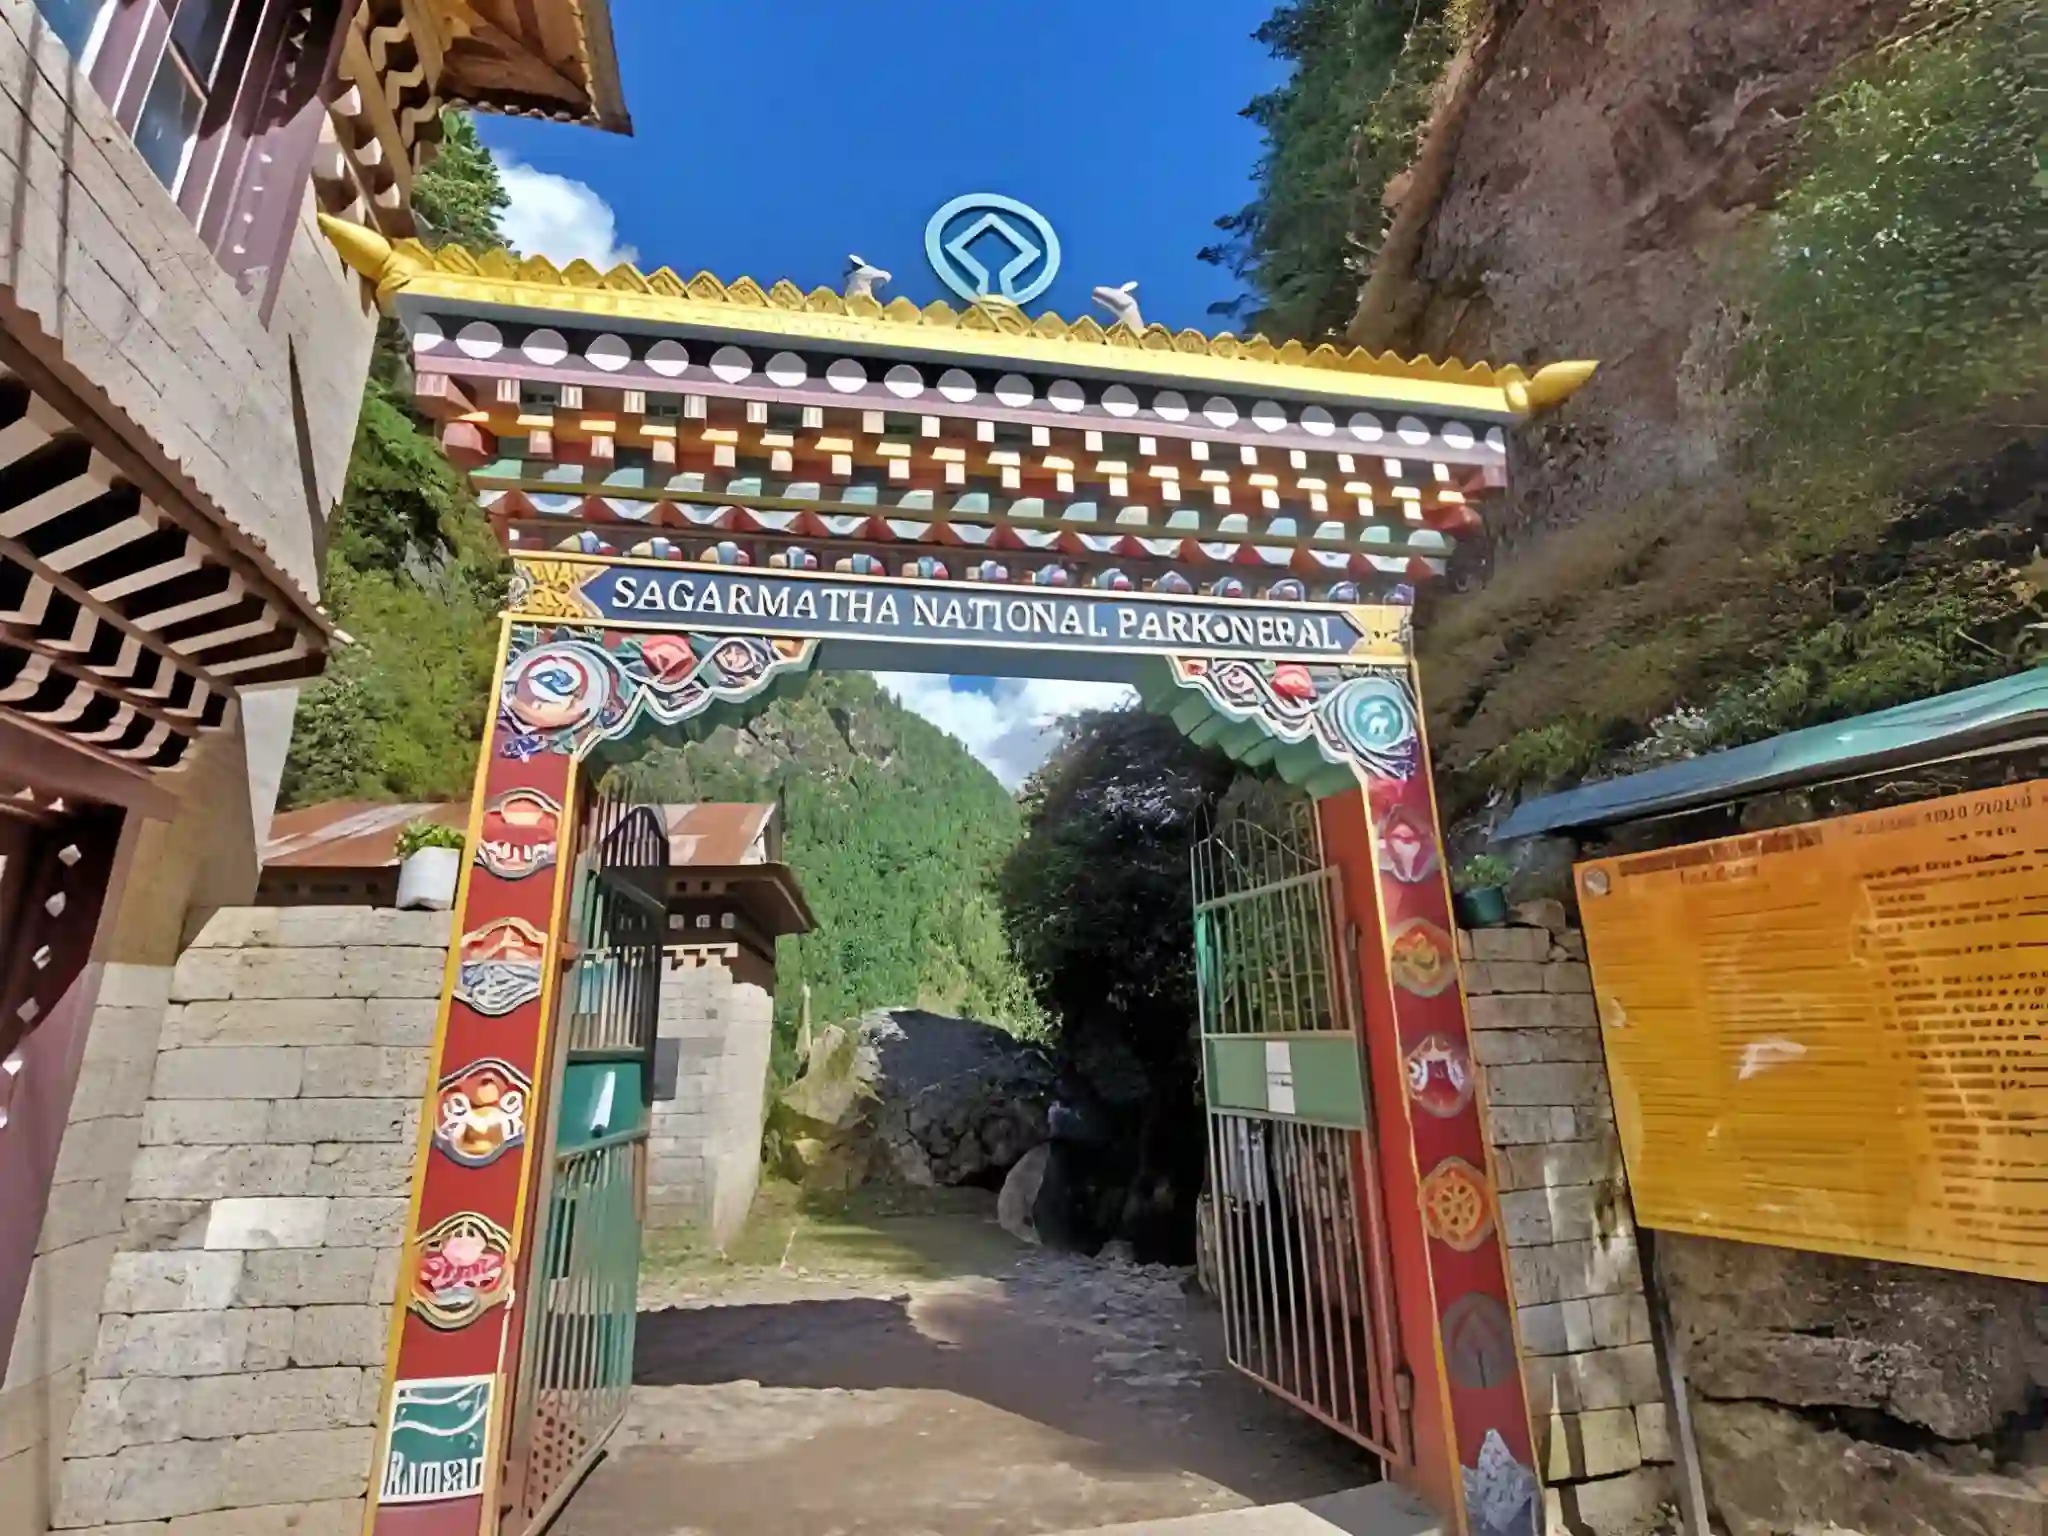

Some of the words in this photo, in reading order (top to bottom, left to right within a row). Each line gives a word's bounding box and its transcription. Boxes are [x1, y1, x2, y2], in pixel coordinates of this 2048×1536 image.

[612, 576, 900, 626] SAGARMATHA
[913, 594, 1108, 638] NATIONAL
[1117, 608, 1217, 644] PARK
